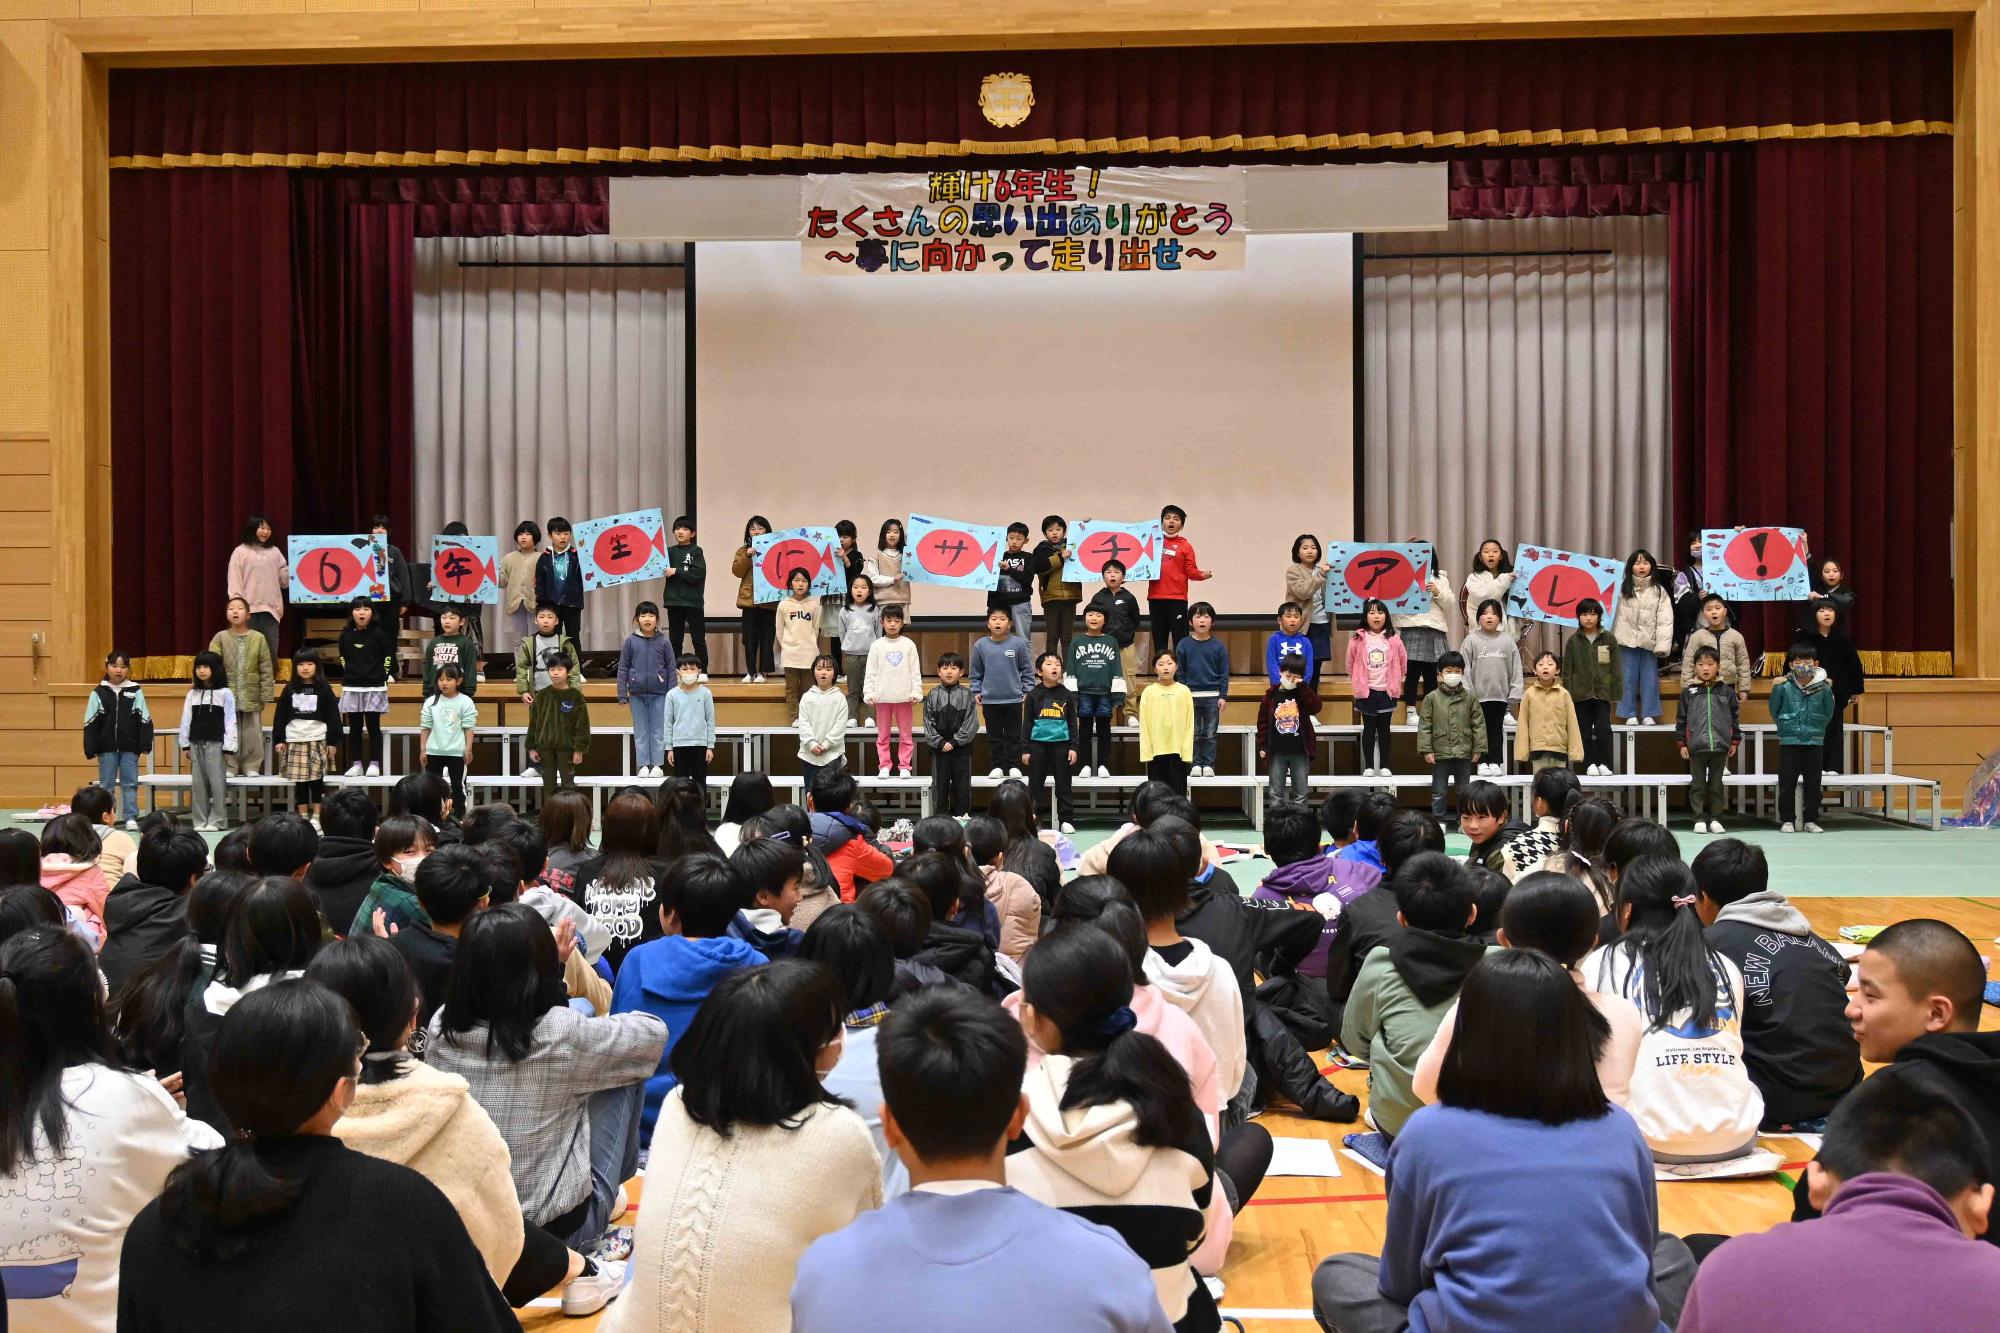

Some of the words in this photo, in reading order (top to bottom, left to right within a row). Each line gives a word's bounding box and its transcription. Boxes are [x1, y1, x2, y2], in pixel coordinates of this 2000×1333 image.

[807, 203, 1234, 240] たくさんの思い出ありがとう
[609, 533, 633, 561] 生
[933, 538, 969, 566] サ
[1091, 534, 1131, 560] チ
[319, 551, 342, 593] 6
[442, 551, 473, 588] 年
[1357, 557, 1401, 591] ア
[1547, 574, 1578, 607] レ
[789, 611, 812, 621] FILA
[1743, 952, 1773, 1007] NEW
[1656, 1053, 1689, 1067] LIFE
[1693, 1052, 1736, 1066] STYLE
